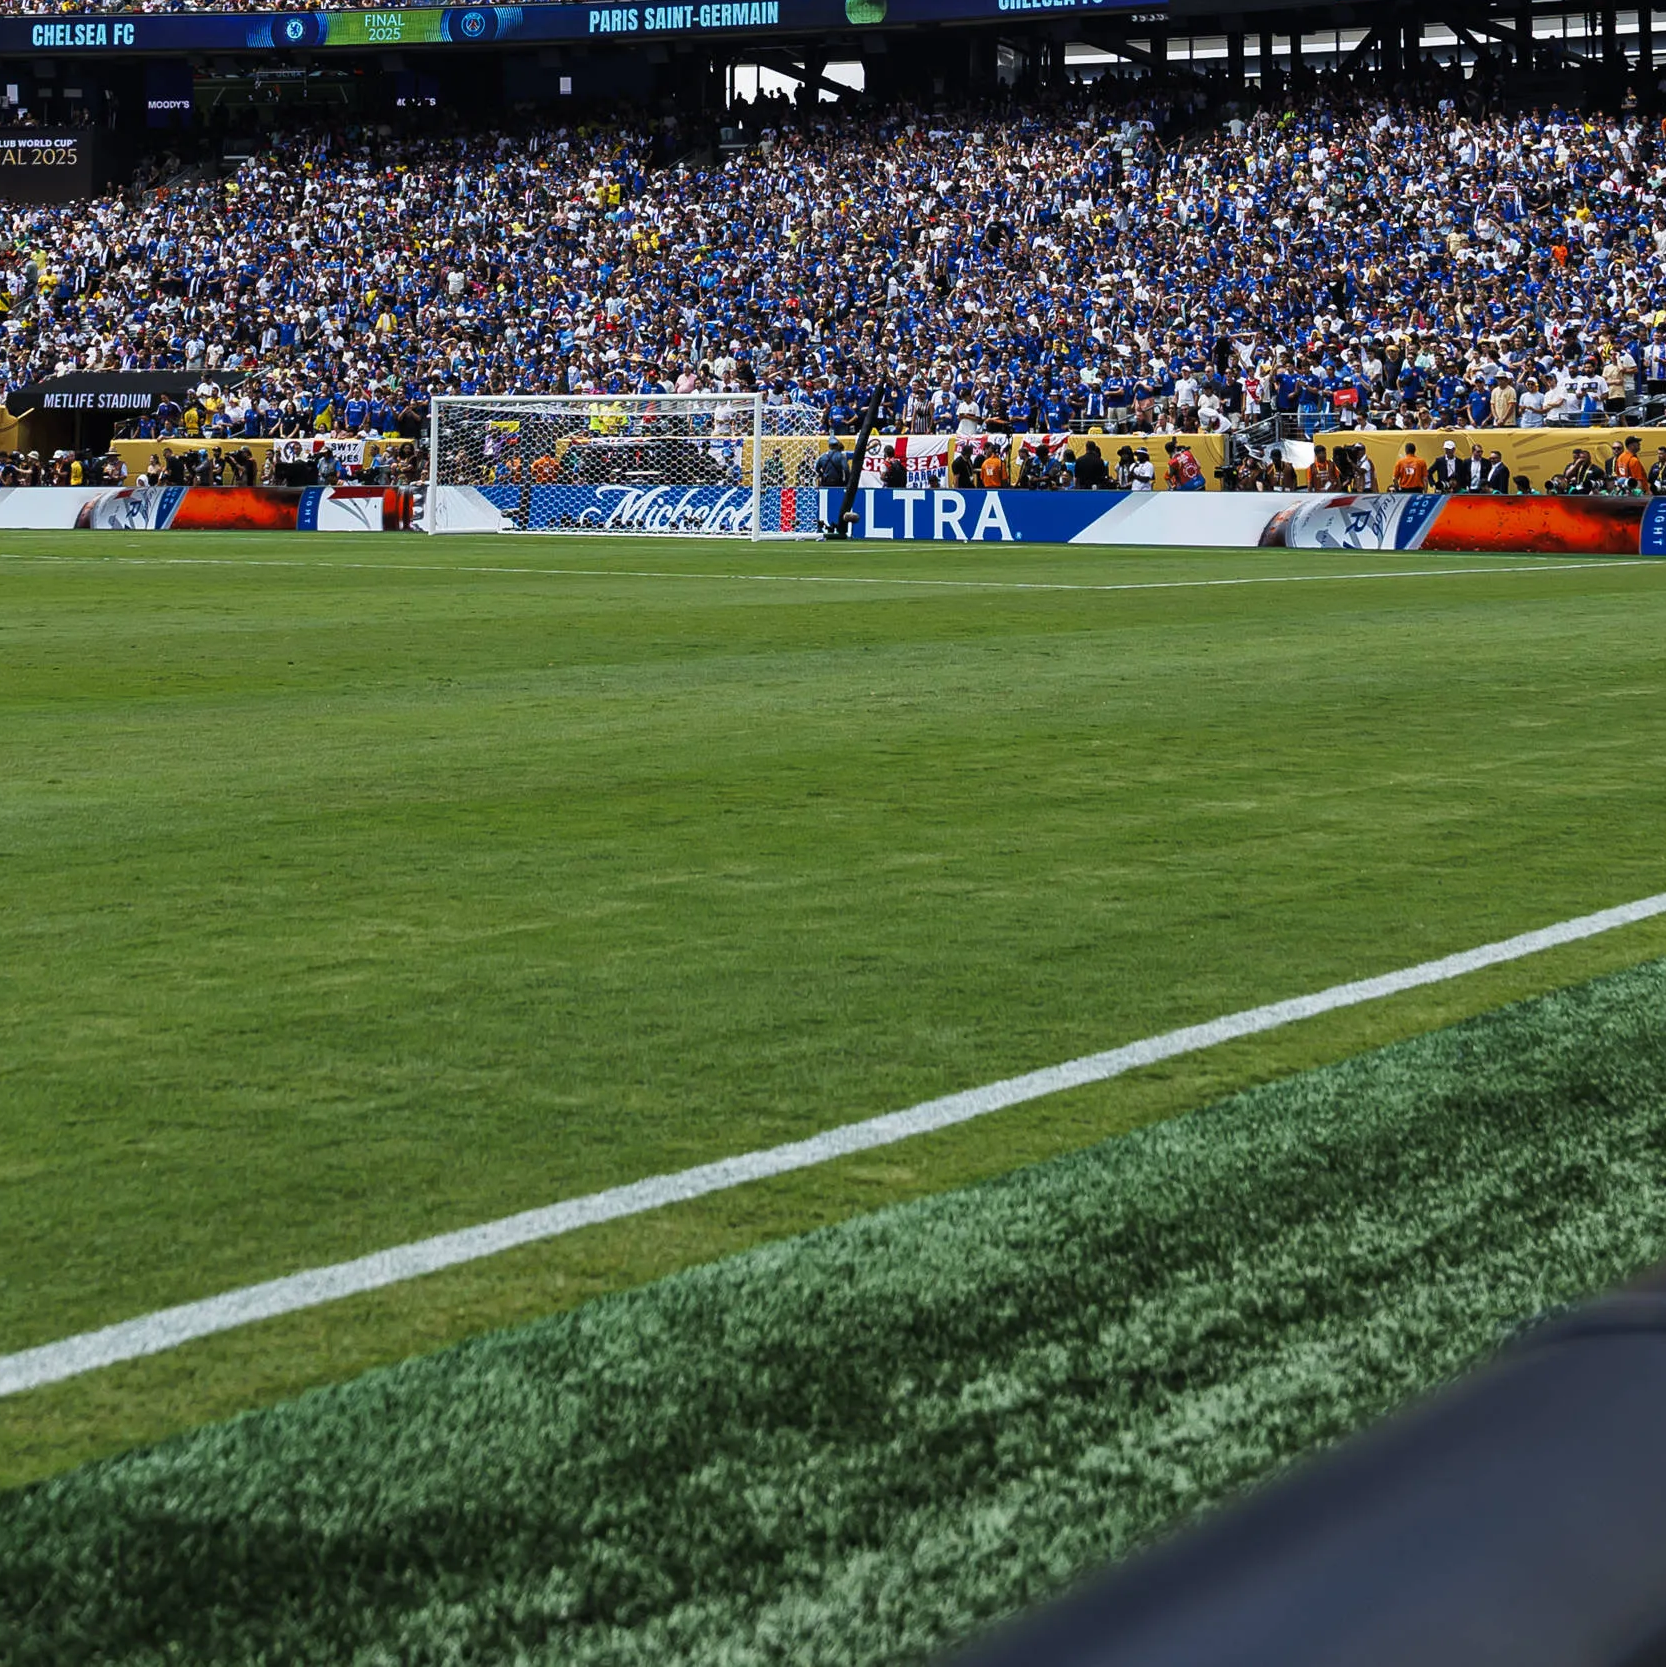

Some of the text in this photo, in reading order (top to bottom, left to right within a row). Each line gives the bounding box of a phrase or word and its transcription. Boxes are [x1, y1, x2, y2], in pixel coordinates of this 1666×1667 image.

[364, 13, 406, 28] FINAL
[588, 1, 779, 34] PARIS SAINT-GERMAIN
[32, 22, 135, 47] CHELSEA FC
[368, 27, 402, 42] 2025
[148, 99, 190, 110] MOODY'S
[18, 139, 52, 149] WORLD
[31, 148, 78, 165] 2025
[43, 393, 152, 409] METLIFE STADIUM
[862, 457, 941, 472] CHSEA
[1653, 502, 1666, 546] LIGHT
